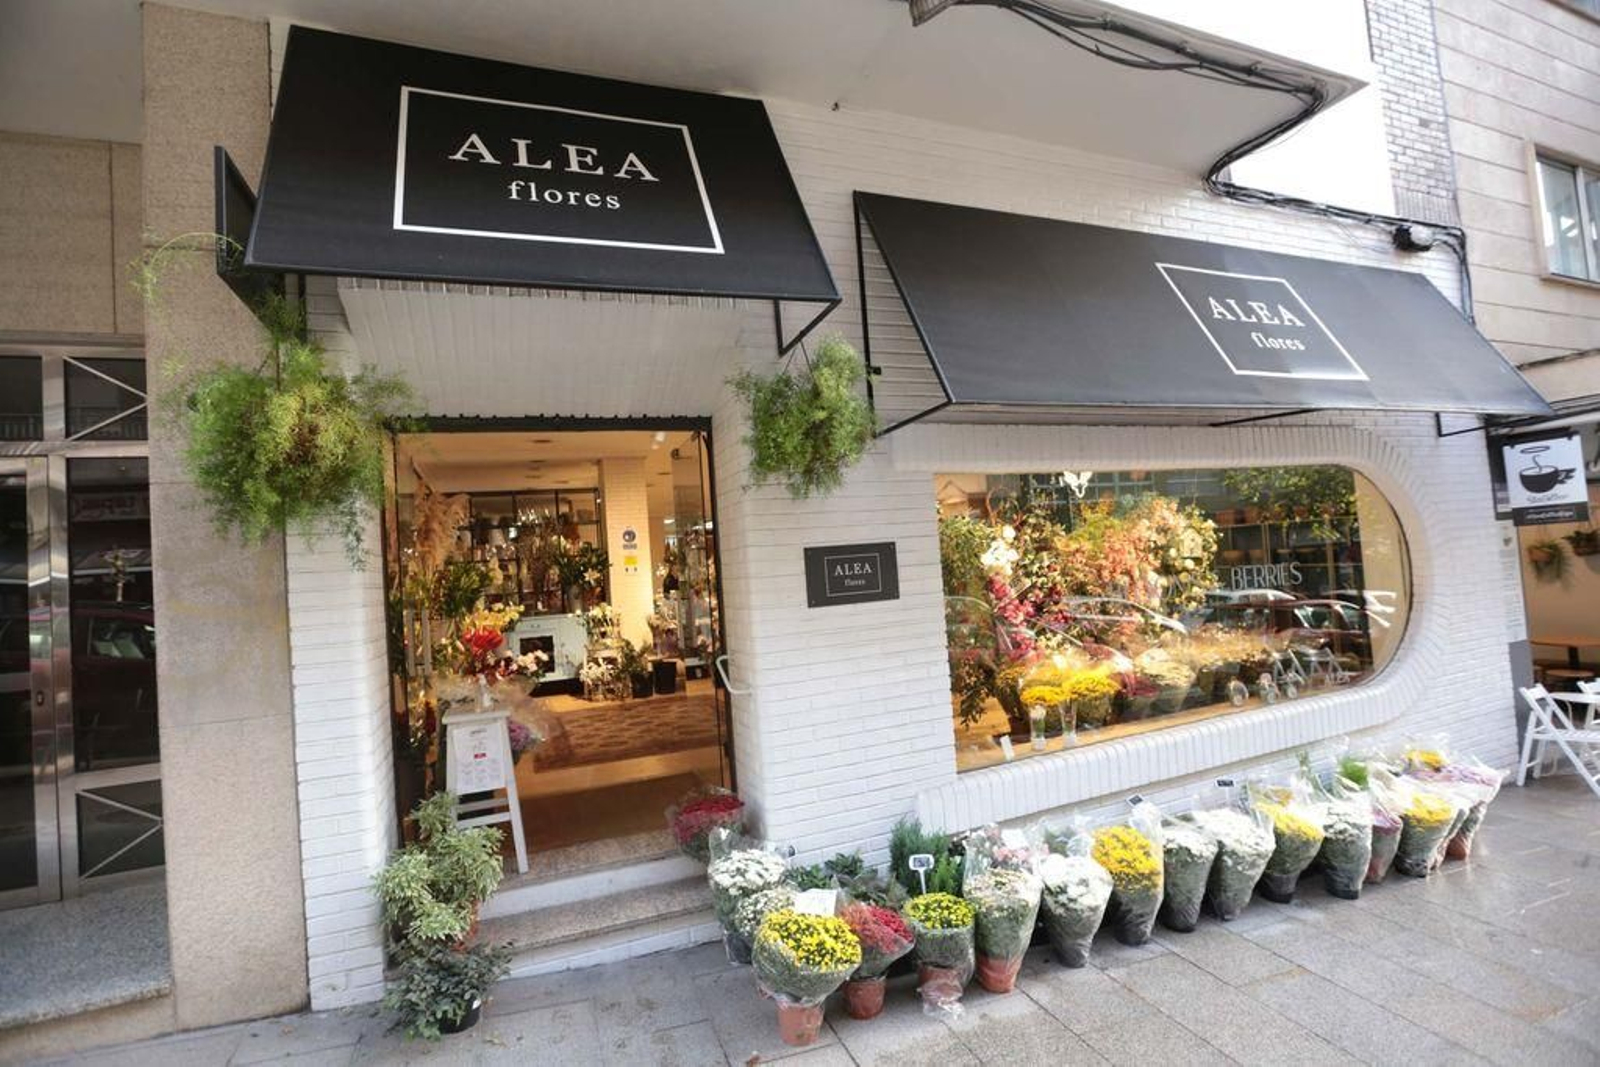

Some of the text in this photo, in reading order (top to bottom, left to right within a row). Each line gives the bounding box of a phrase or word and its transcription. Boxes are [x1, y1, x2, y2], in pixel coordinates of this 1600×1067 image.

[448, 133, 660, 182] ALEA
[508, 180, 621, 209] flores
[1208, 295, 1306, 327] ALEA
[1250, 331, 1306, 351] flores
[834, 562, 873, 576] ALEA
[1230, 561, 1303, 591] BERRIES
